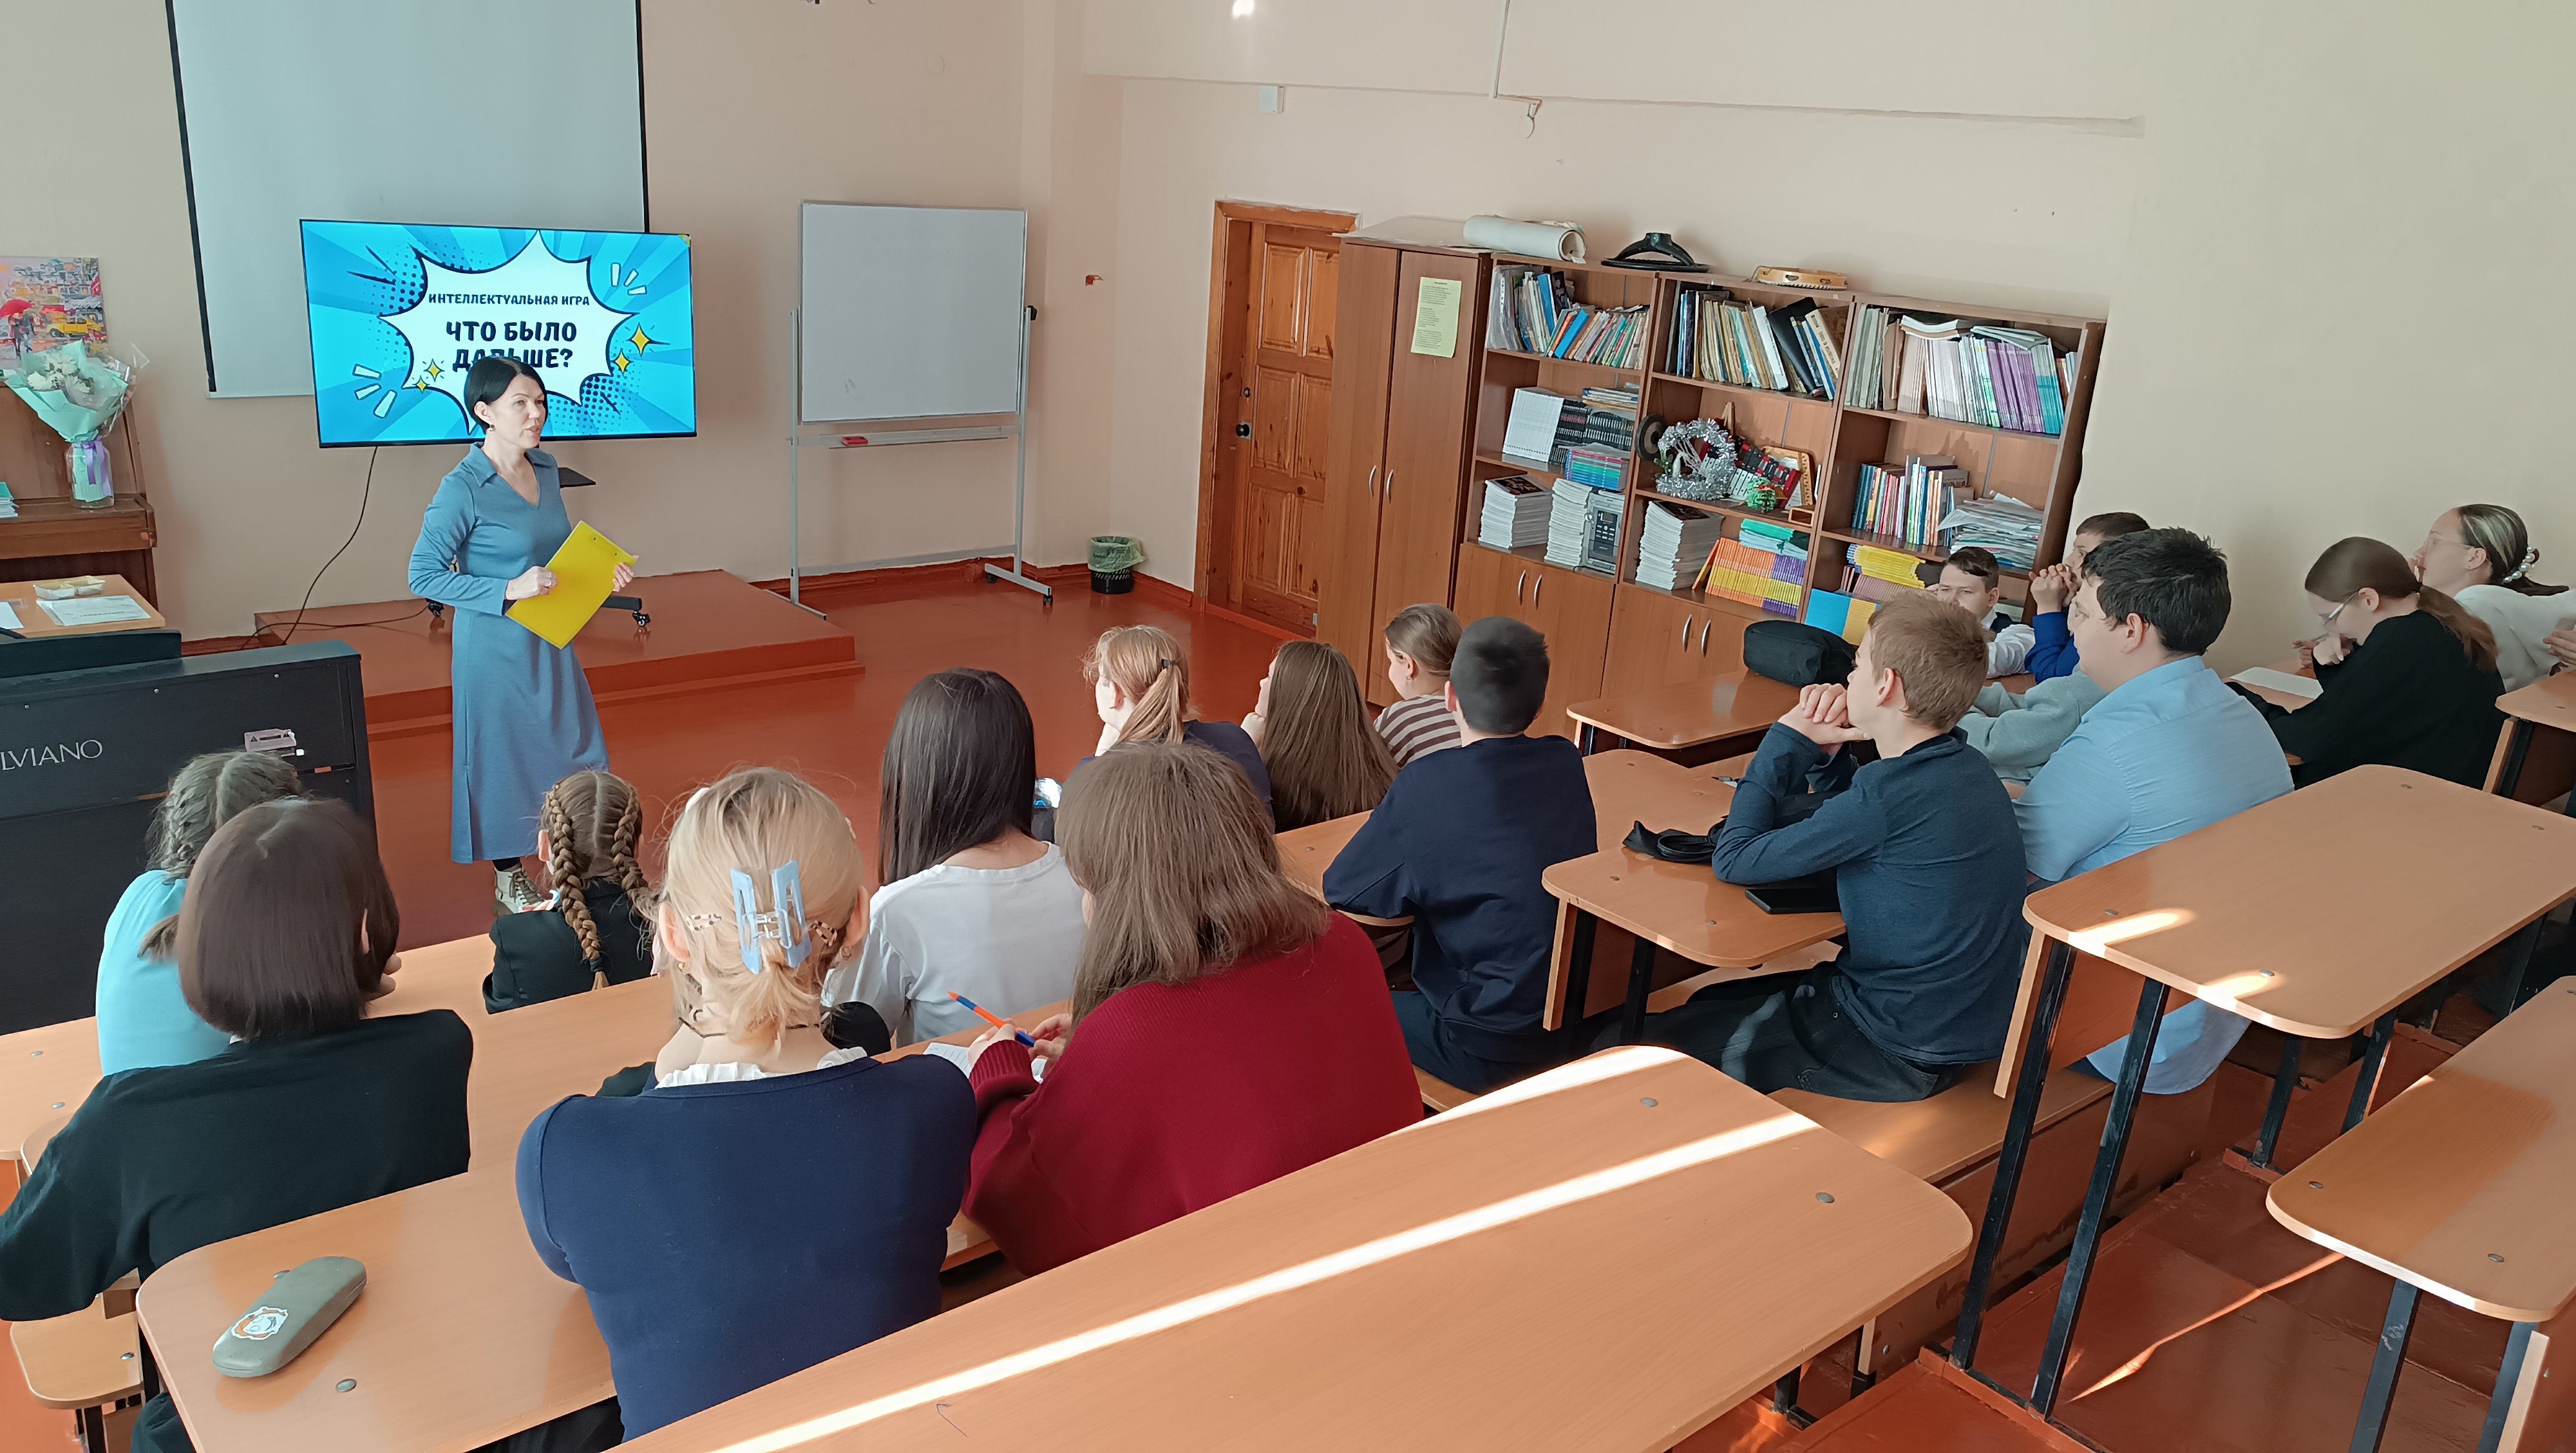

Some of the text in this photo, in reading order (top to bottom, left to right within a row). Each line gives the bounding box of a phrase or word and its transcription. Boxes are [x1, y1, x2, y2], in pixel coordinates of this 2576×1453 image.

[429, 294, 589, 305] ИНТЕЛЛЕКТУАЛЬНАЯ ИГРА
[446, 321, 576, 341] ЧТО БЫЛО
